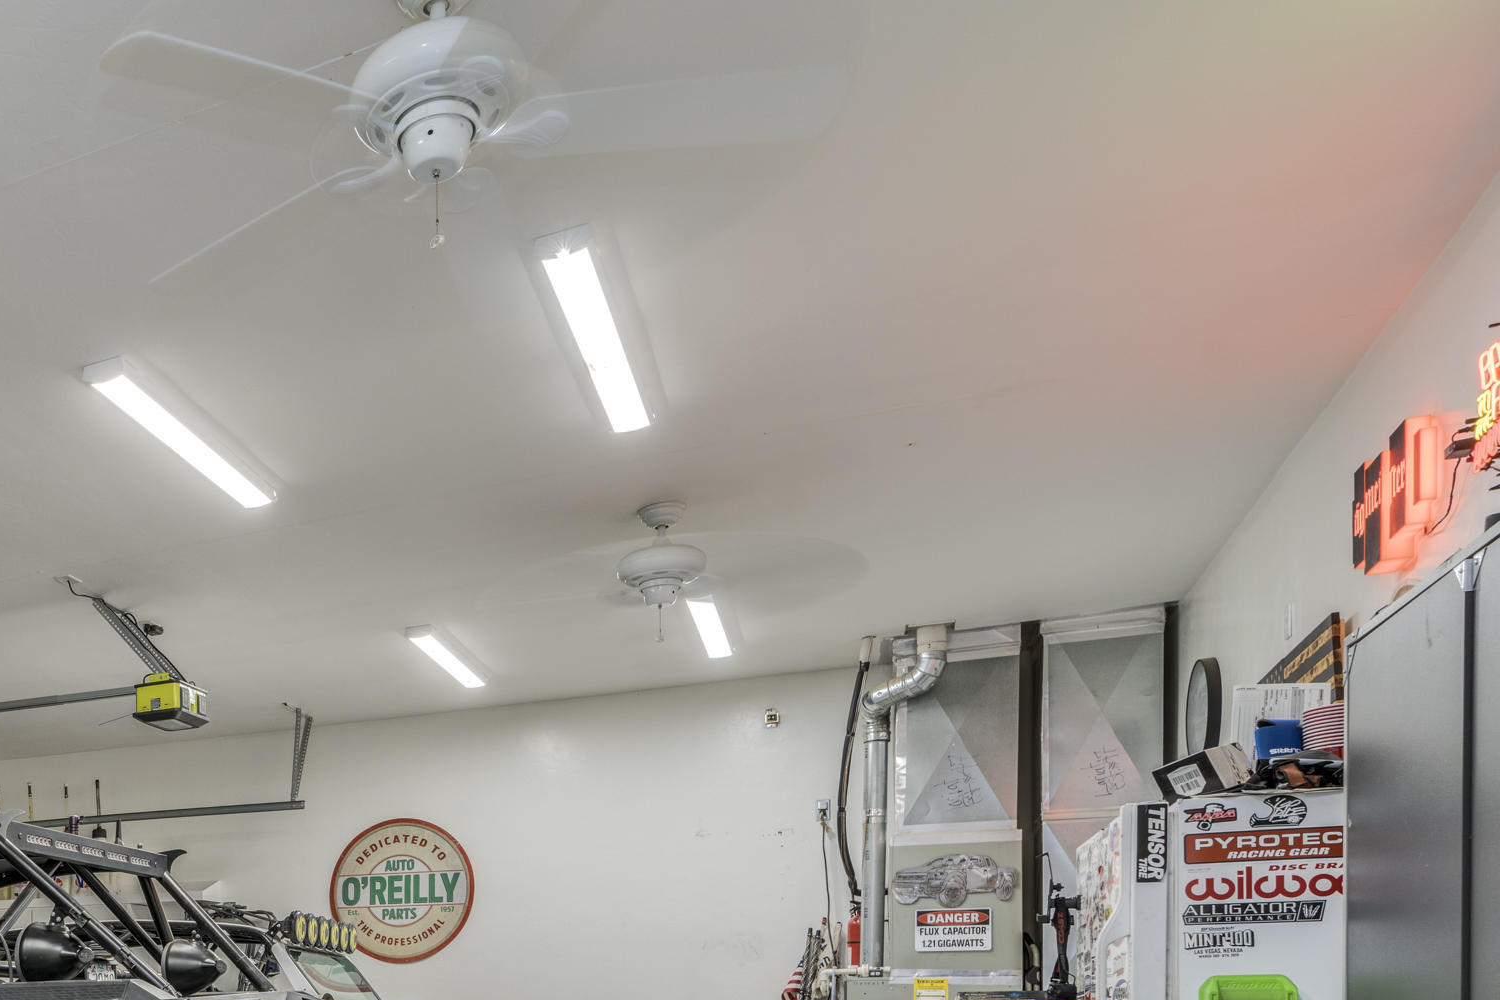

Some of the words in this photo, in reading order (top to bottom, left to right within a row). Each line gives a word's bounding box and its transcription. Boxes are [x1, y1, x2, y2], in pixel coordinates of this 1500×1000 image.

[1147, 807, 1166, 881] TENSOR
[1194, 831, 1344, 850] PYROTEC
[355, 834, 428, 865] DEDICATED
[431, 844, 447, 861] TO
[1227, 849, 1287, 859] RACING
[1289, 847, 1330, 857] GEAR
[384, 859, 415, 872] AUTO
[1138, 858, 1148, 879] TIRE
[1268, 863, 1308, 872] DISC
[1314, 862, 1344, 870] BR
[341, 872, 461, 907] O'REILLY
[1185, 866, 1344, 902] wilwo
[381, 907, 417, 921] PARTS
[1184, 902, 1297, 916] ALLIGATOR
[926, 912, 980, 924] DANGER
[1188, 914, 1294, 923] PERFORMANCE
[357, 920, 374, 937] THE
[374, 919, 446, 946] PROFESSIONAL
[919, 927, 940, 936] FLUX
[942, 926, 987, 935] CAPACITOR
[921, 940, 936, 948] 1.21
[937, 938, 985, 948] GIGAWATTS
